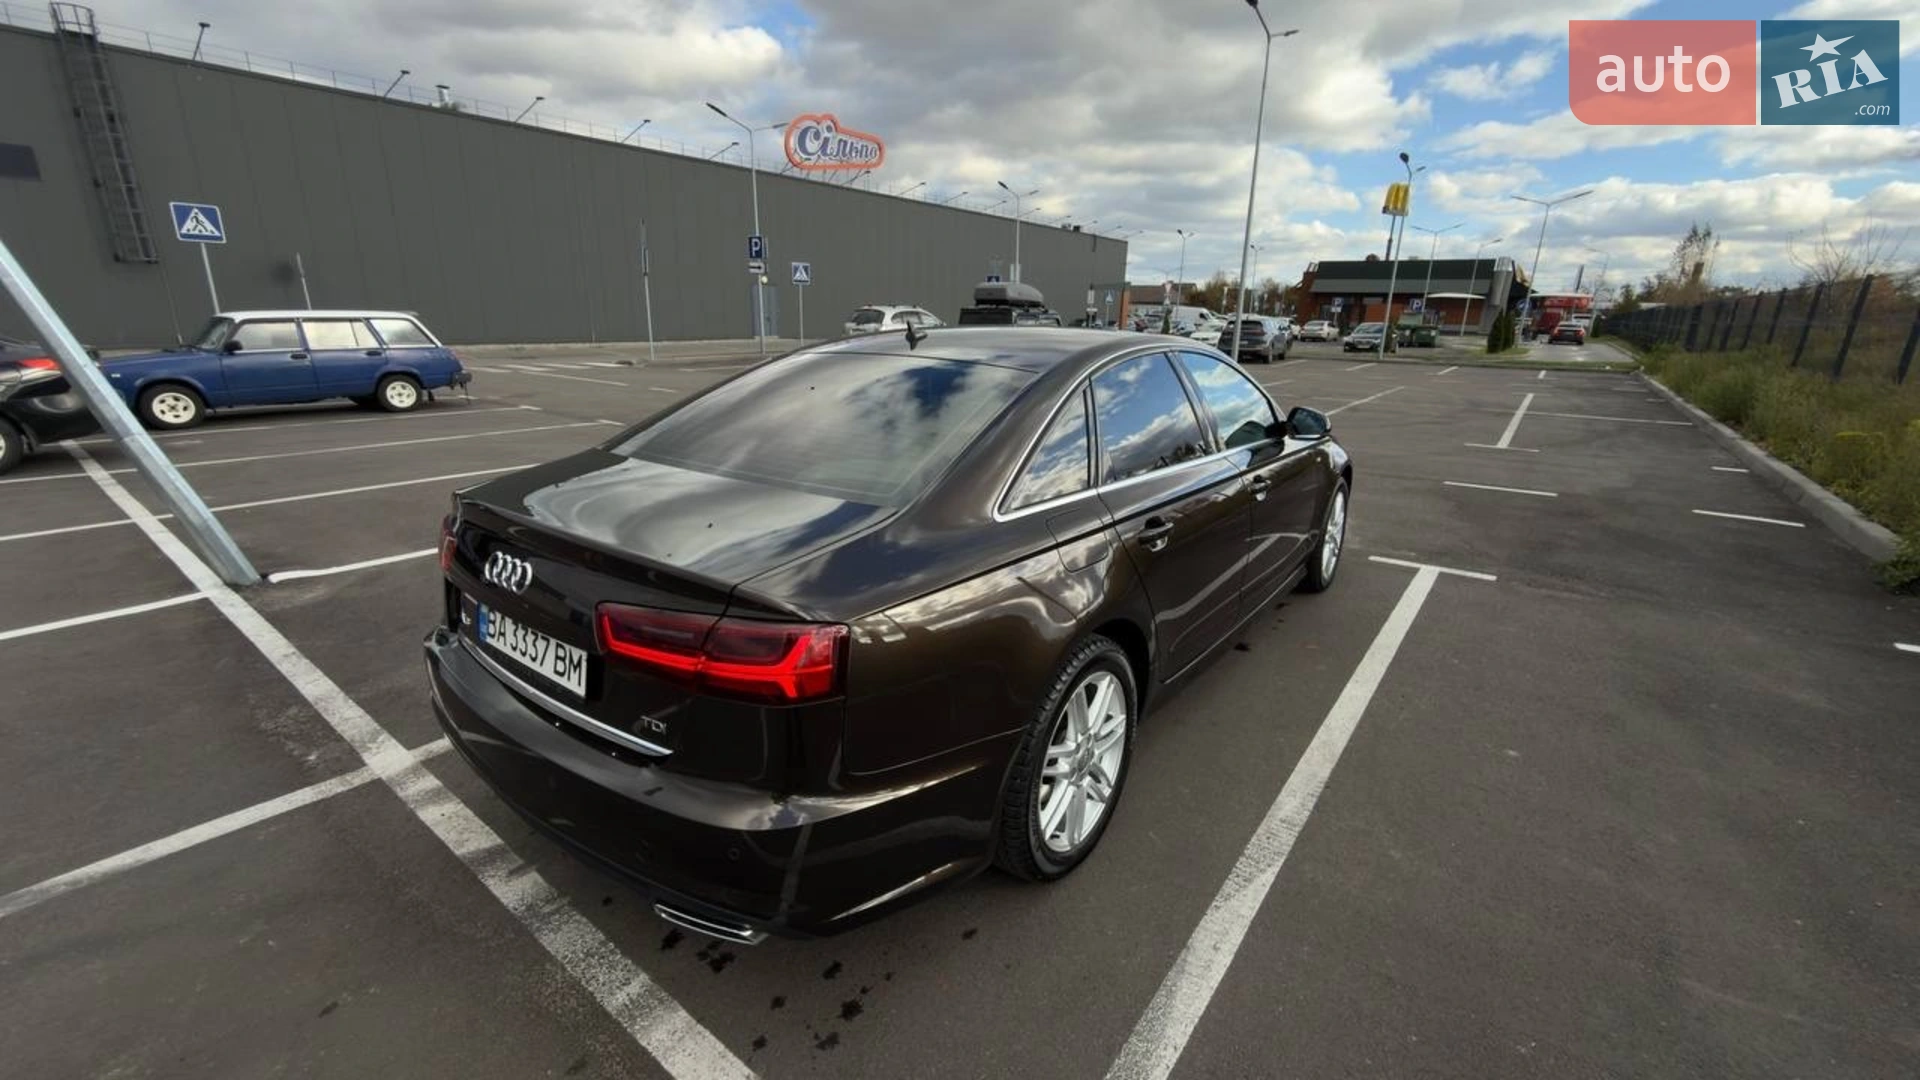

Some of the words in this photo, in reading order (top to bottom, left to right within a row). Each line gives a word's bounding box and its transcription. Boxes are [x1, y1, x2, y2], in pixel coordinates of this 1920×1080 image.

[797, 124, 878, 160] Сільпо
[751, 238, 761, 257] P
[510, 621, 551, 667] 3337
[553, 641, 583, 687] BM
